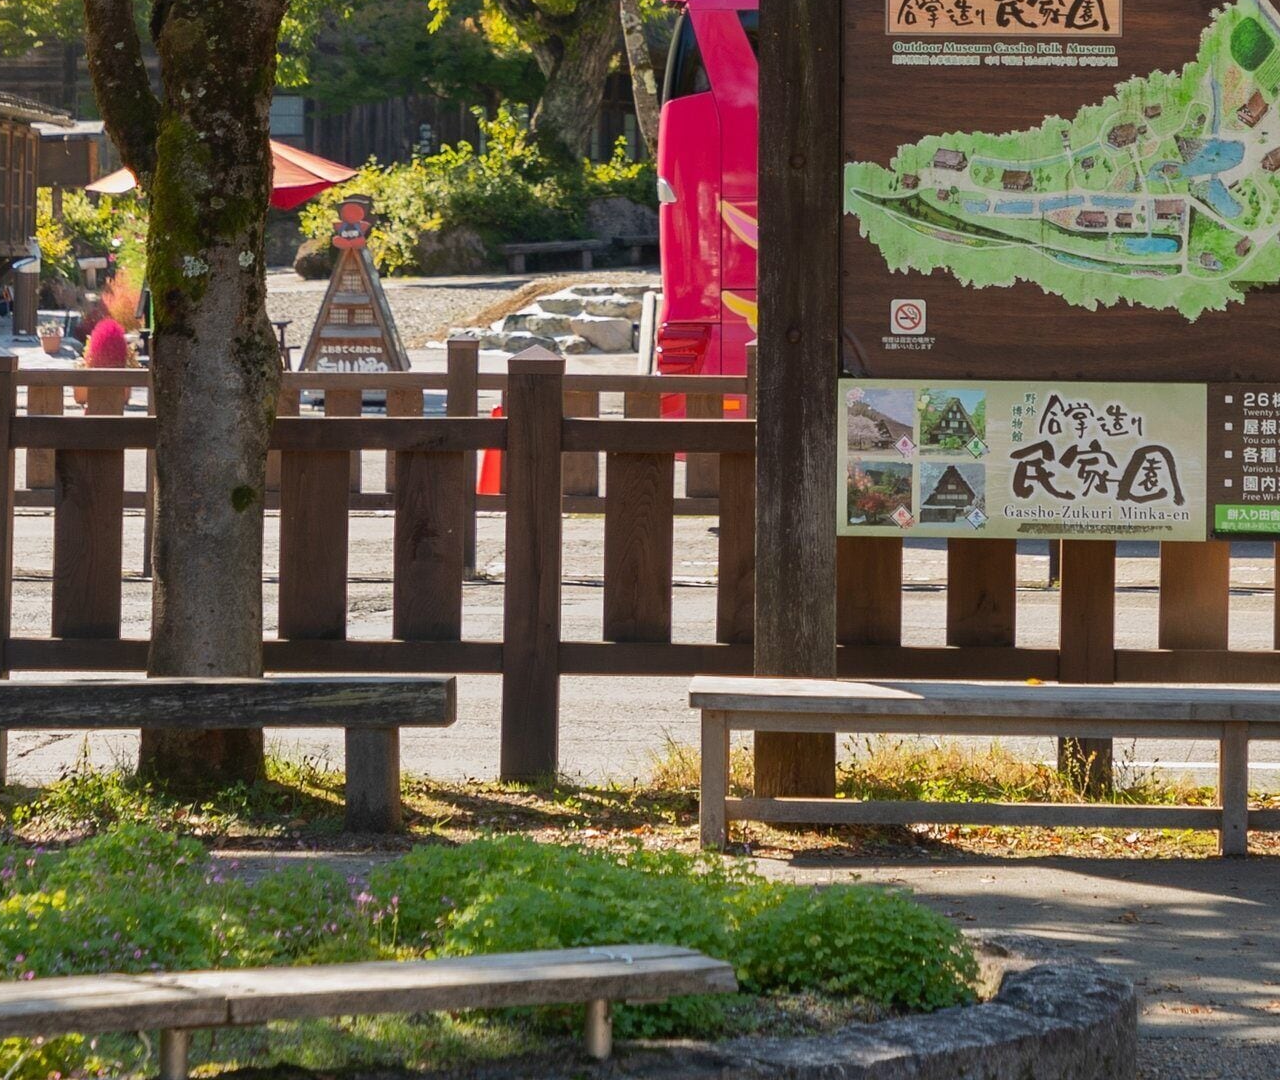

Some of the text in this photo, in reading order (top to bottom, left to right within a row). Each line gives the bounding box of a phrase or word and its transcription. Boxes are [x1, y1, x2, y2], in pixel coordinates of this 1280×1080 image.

[893, 42, 1115, 54] Outdoor Museum Gassho Folk Museum
[1025, 393, 1036, 416] 野外
[1039, 394, 1143, 438] 合掌造り
[1243, 409, 1273, 417] Twenty
[1012, 406, 1023, 442] 博物館
[1243, 436, 1259, 444] You
[1010, 439, 1185, 506] 民家園
[1243, 465, 1273, 473] Various
[1004, 505, 1190, 520] Gassho-Zukuri Minka-en
